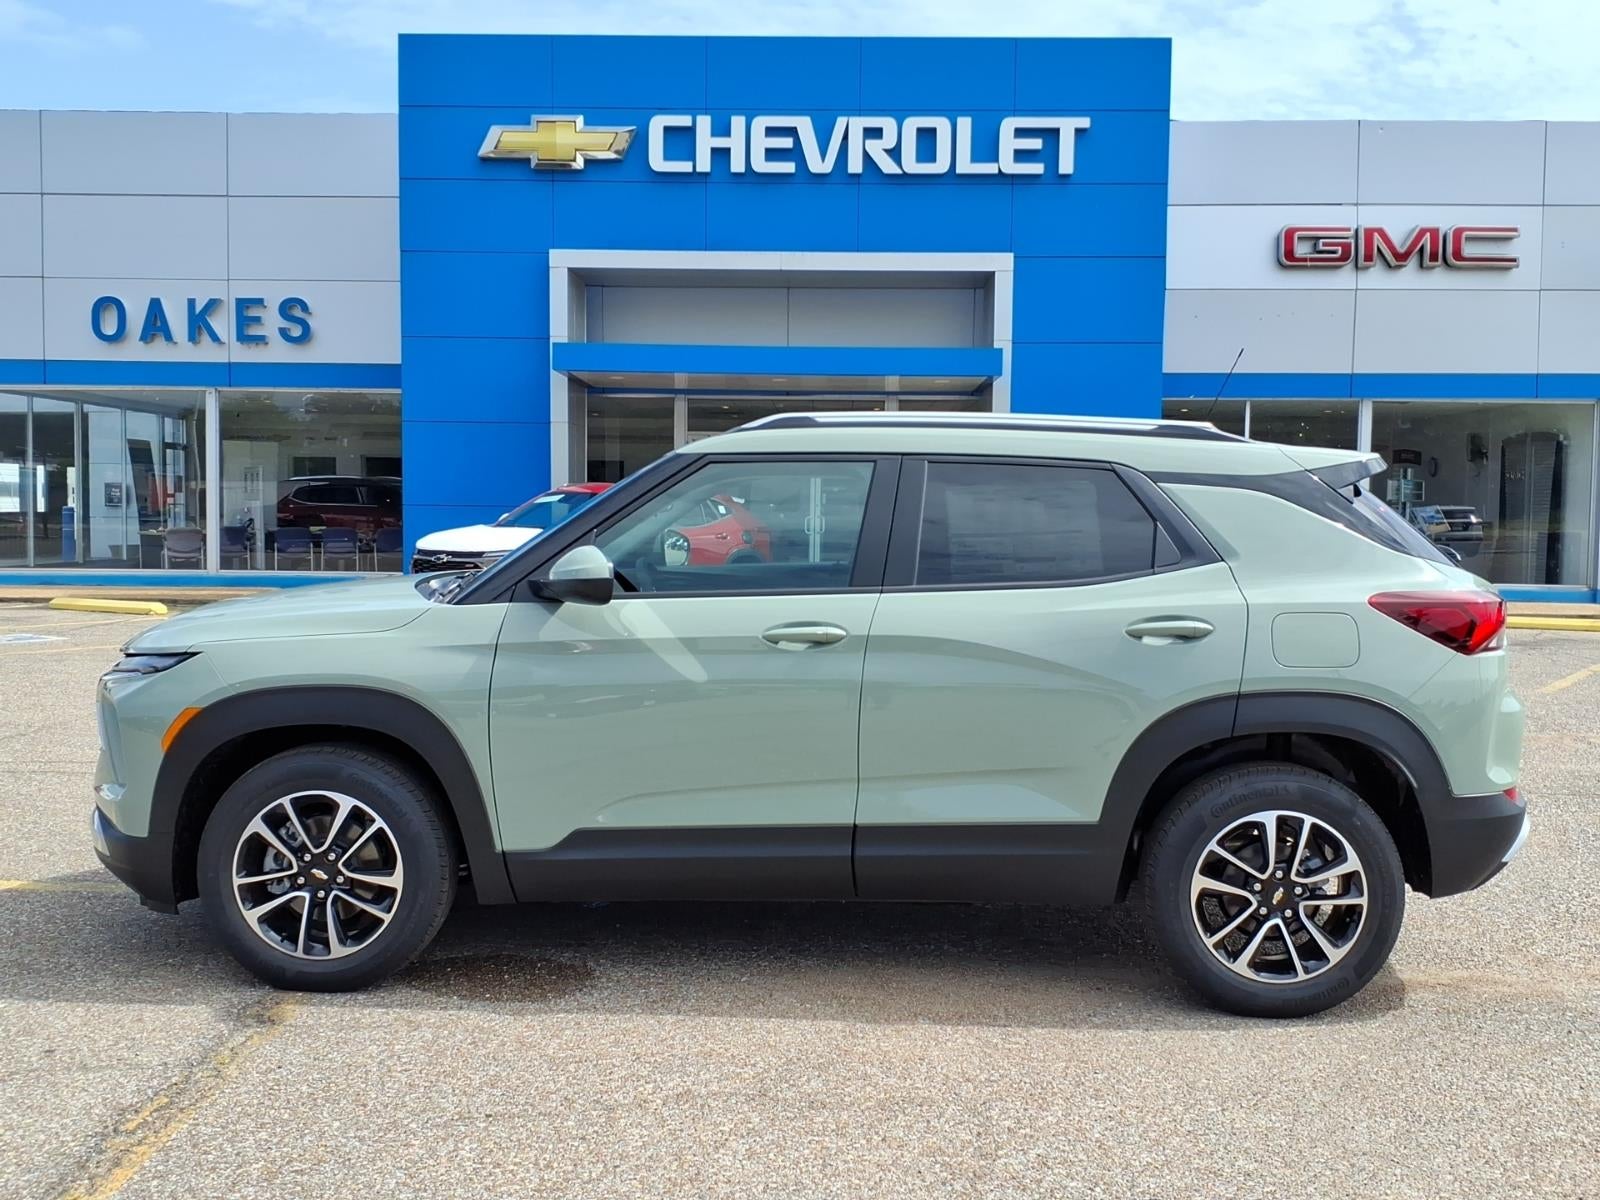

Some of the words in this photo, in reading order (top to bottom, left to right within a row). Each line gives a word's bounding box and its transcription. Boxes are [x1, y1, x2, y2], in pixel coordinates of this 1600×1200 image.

[648, 114, 1091, 176] CHEVROLET
[1278, 224, 1520, 269] GMC
[91, 295, 313, 345] OAKES
